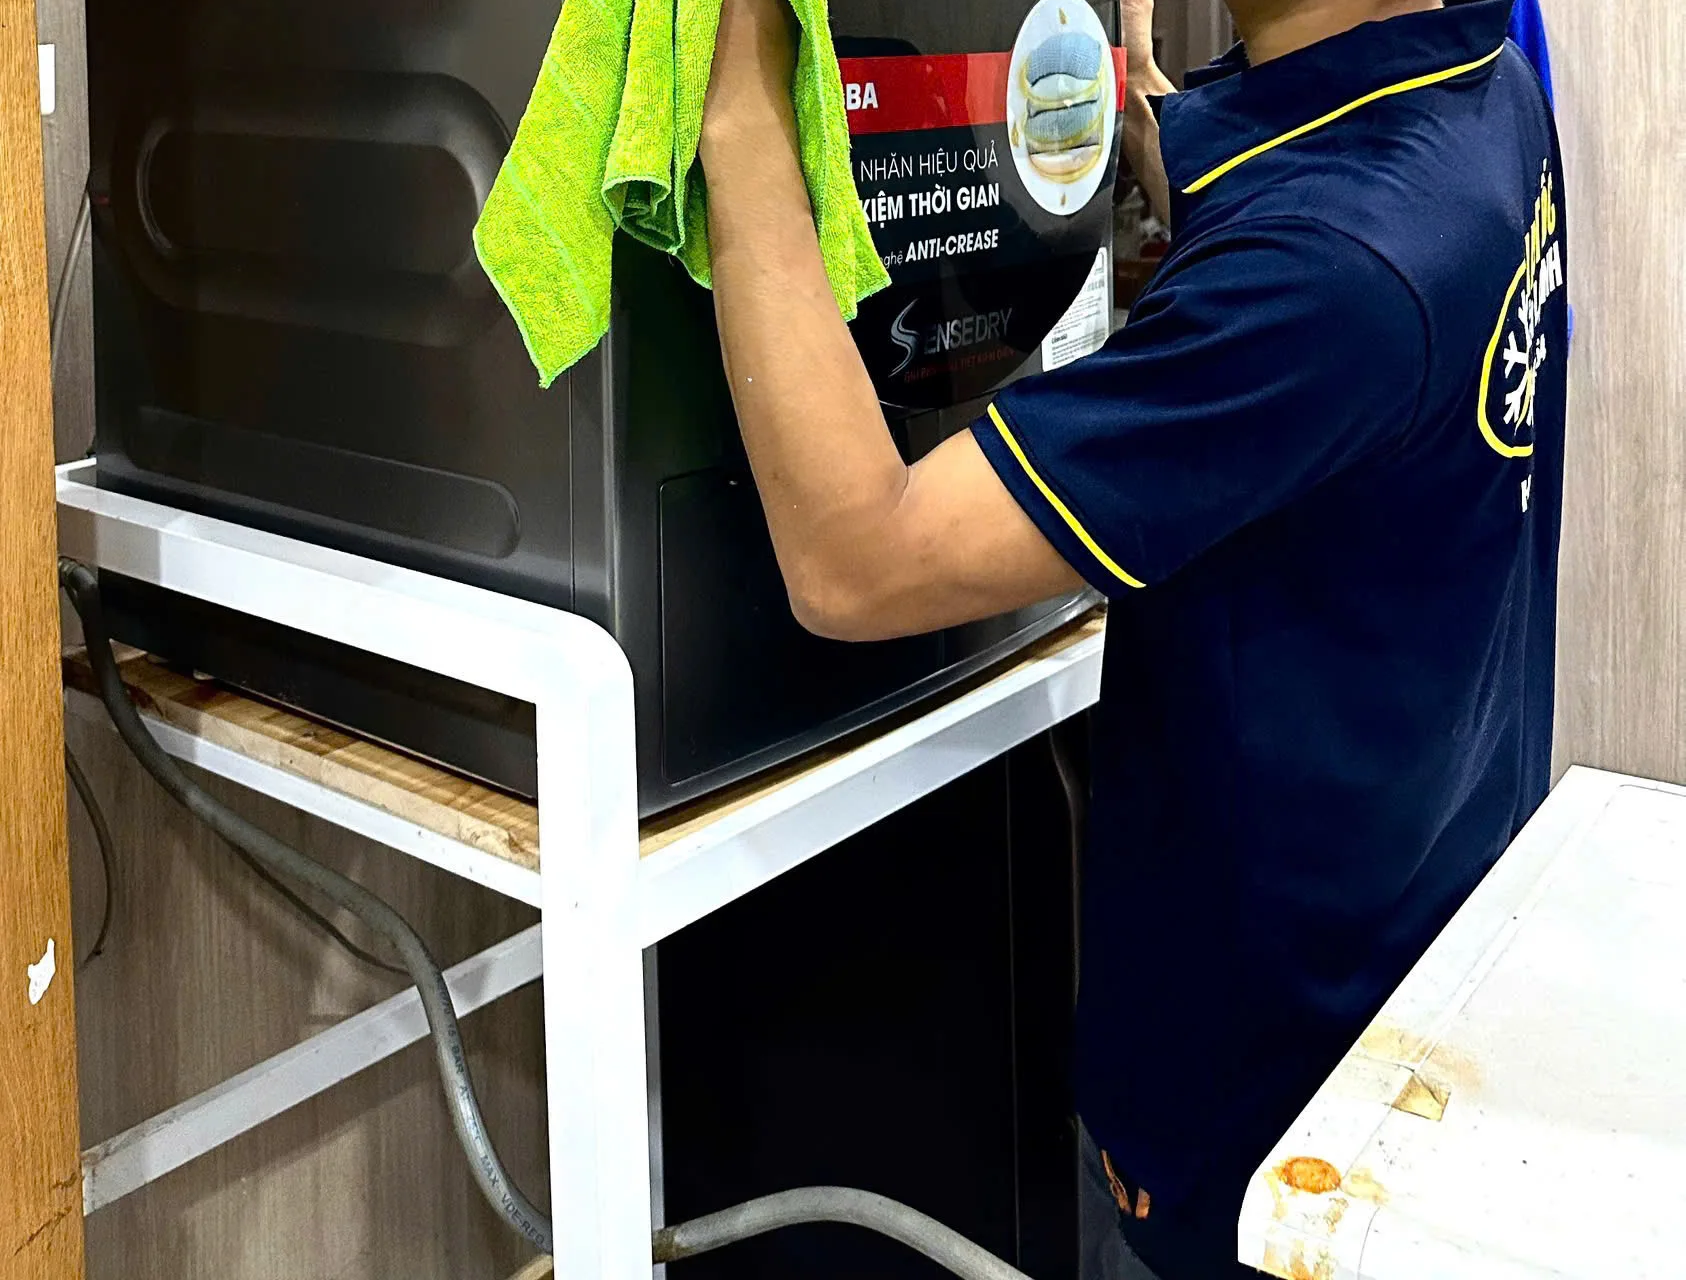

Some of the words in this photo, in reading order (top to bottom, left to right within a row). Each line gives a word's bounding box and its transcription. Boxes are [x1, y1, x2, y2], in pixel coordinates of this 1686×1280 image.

[860, 151, 913, 182] NHĂN
[919, 147, 958, 177] HIỆU
[963, 139, 999, 173] QUẢ
[859, 190, 904, 229] KIỆM
[908, 183, 952, 217] THỜI
[956, 182, 1000, 211] GIAN
[905, 228, 1000, 263] ANTI-CREASE
[452, 1045, 465, 1075] BAR
[480, 1153, 500, 1188] MAX
